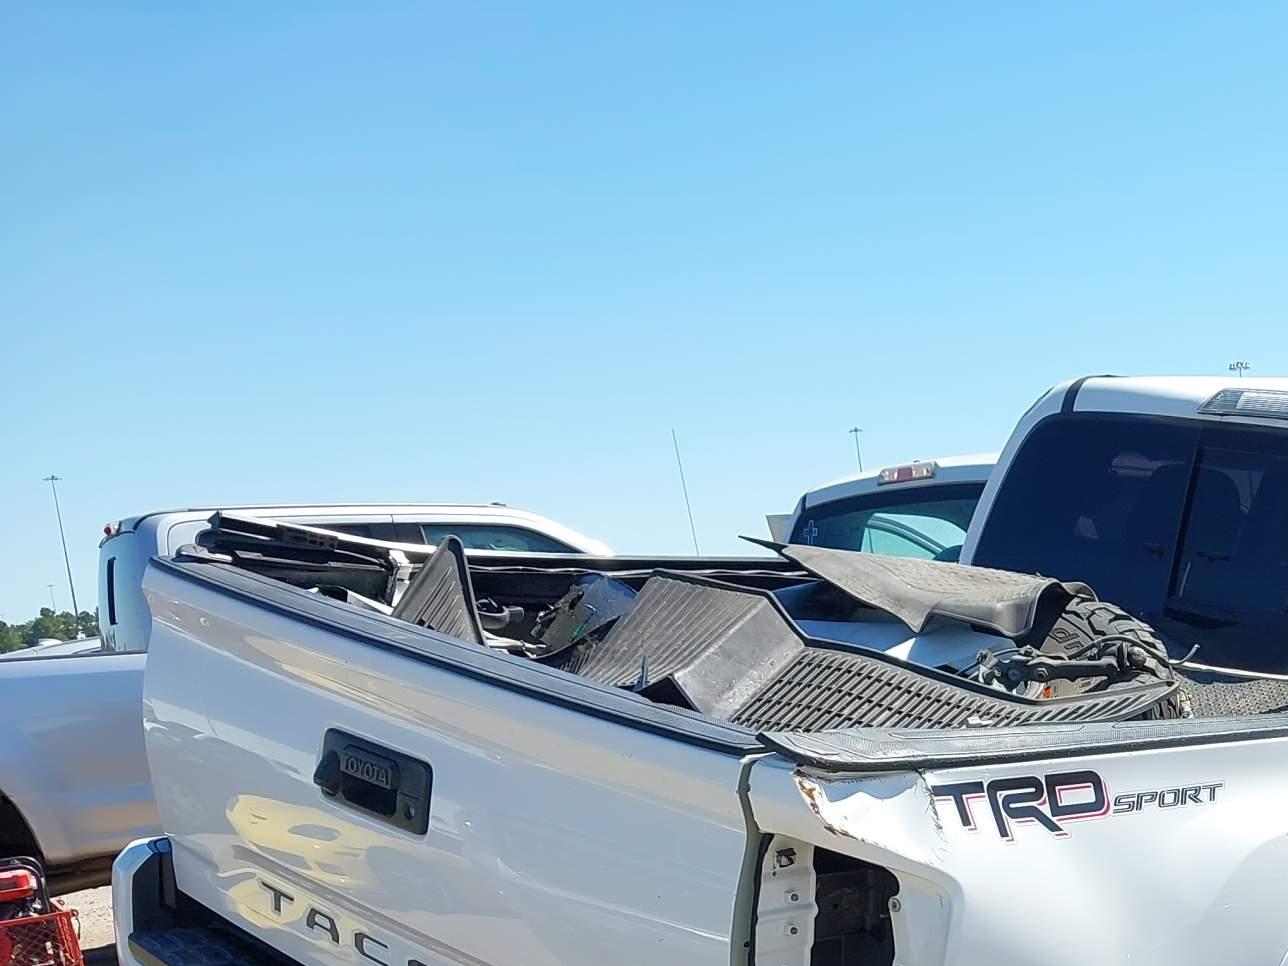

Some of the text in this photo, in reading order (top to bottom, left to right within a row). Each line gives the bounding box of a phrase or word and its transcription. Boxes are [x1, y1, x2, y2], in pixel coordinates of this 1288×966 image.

[342, 754, 389, 787] TOYOTA
[930, 769, 1224, 842] TRD SPORT
